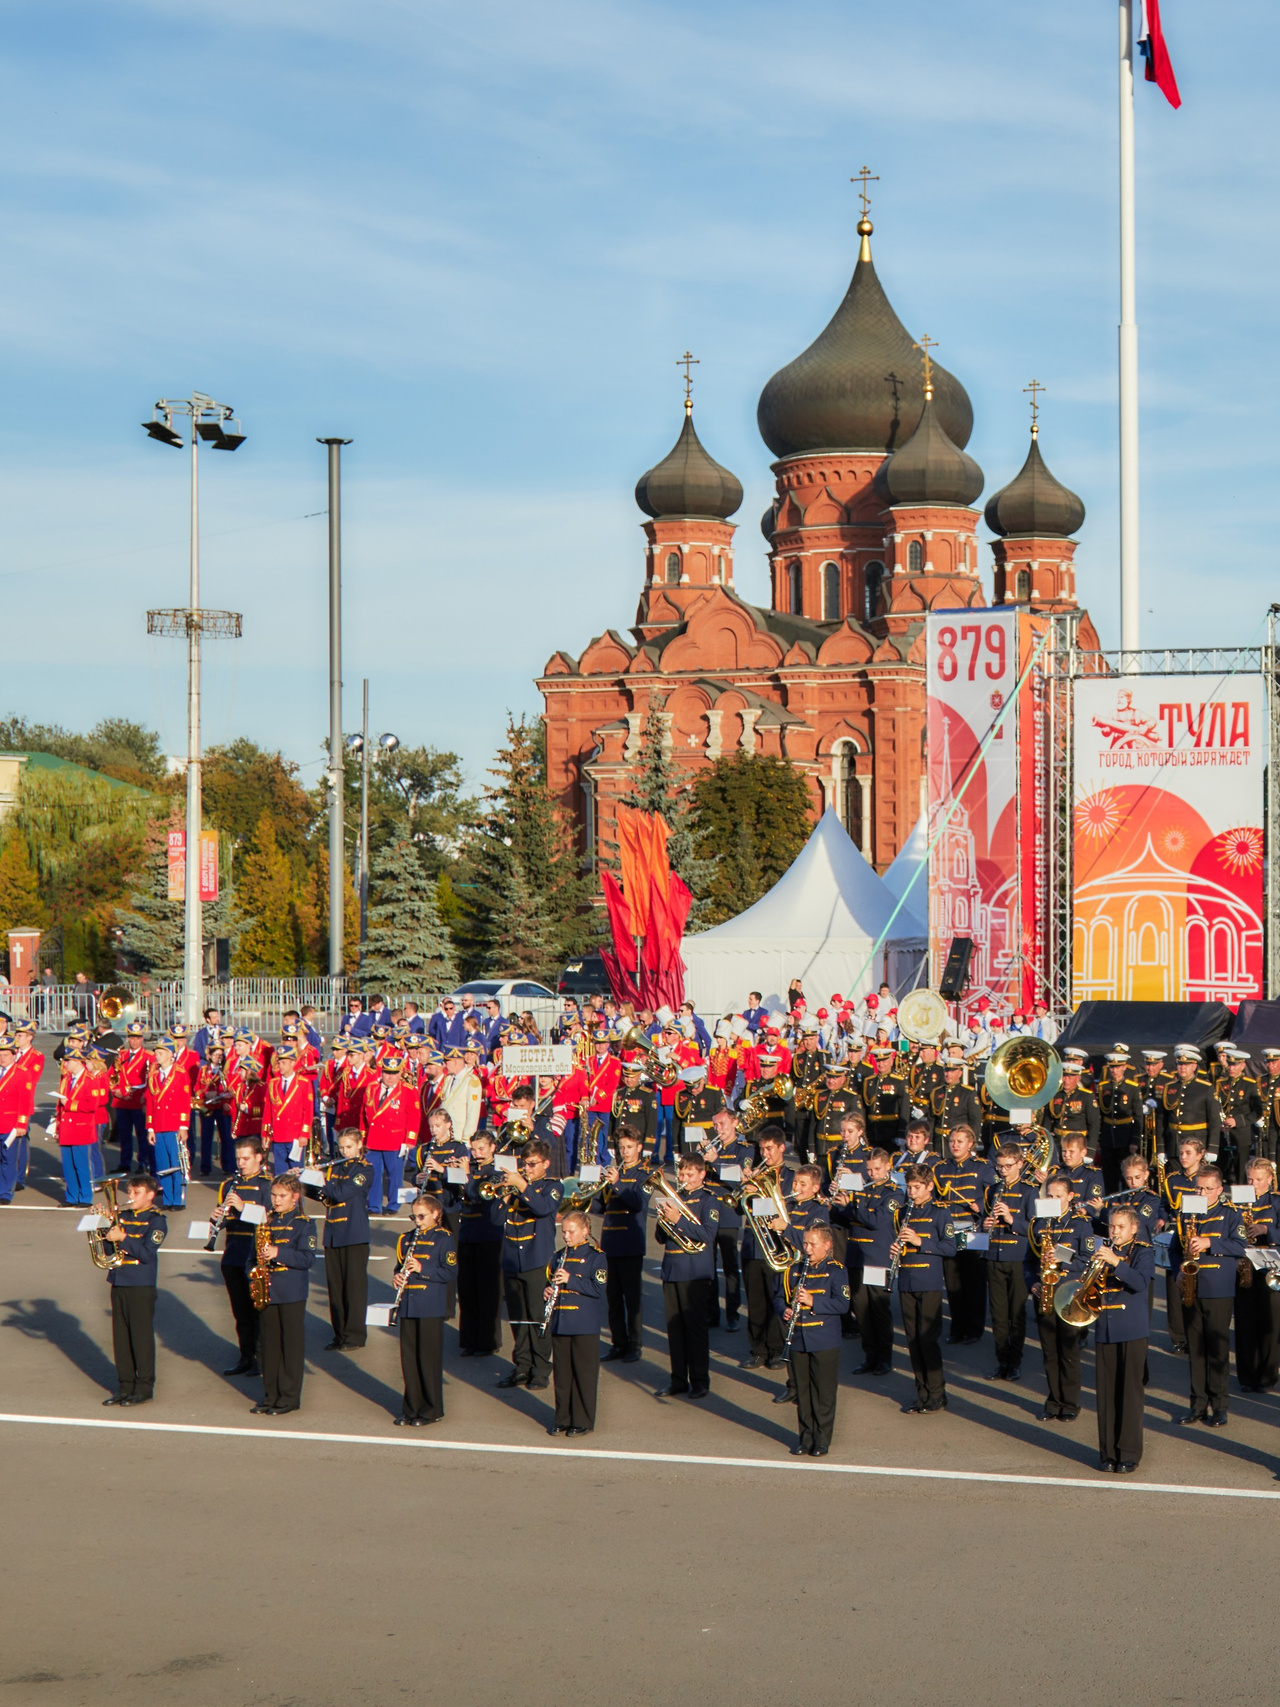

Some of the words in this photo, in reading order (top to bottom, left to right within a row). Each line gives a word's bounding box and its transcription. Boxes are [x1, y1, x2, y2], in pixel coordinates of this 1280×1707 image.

[937, 624, 1006, 682] 879
[1159, 702, 1250, 748] ТУЛА
[1099, 752, 1135, 770] ГОРОД,
[1137, 750, 1187, 767] КОТОРЫЙ
[1189, 750, 1250, 766] ЗАРЯЖАЕТ
[169, 833, 182, 846] 879
[520, 1049, 555, 1062] ИСТРА
[505, 1064, 552, 1073] Московская
